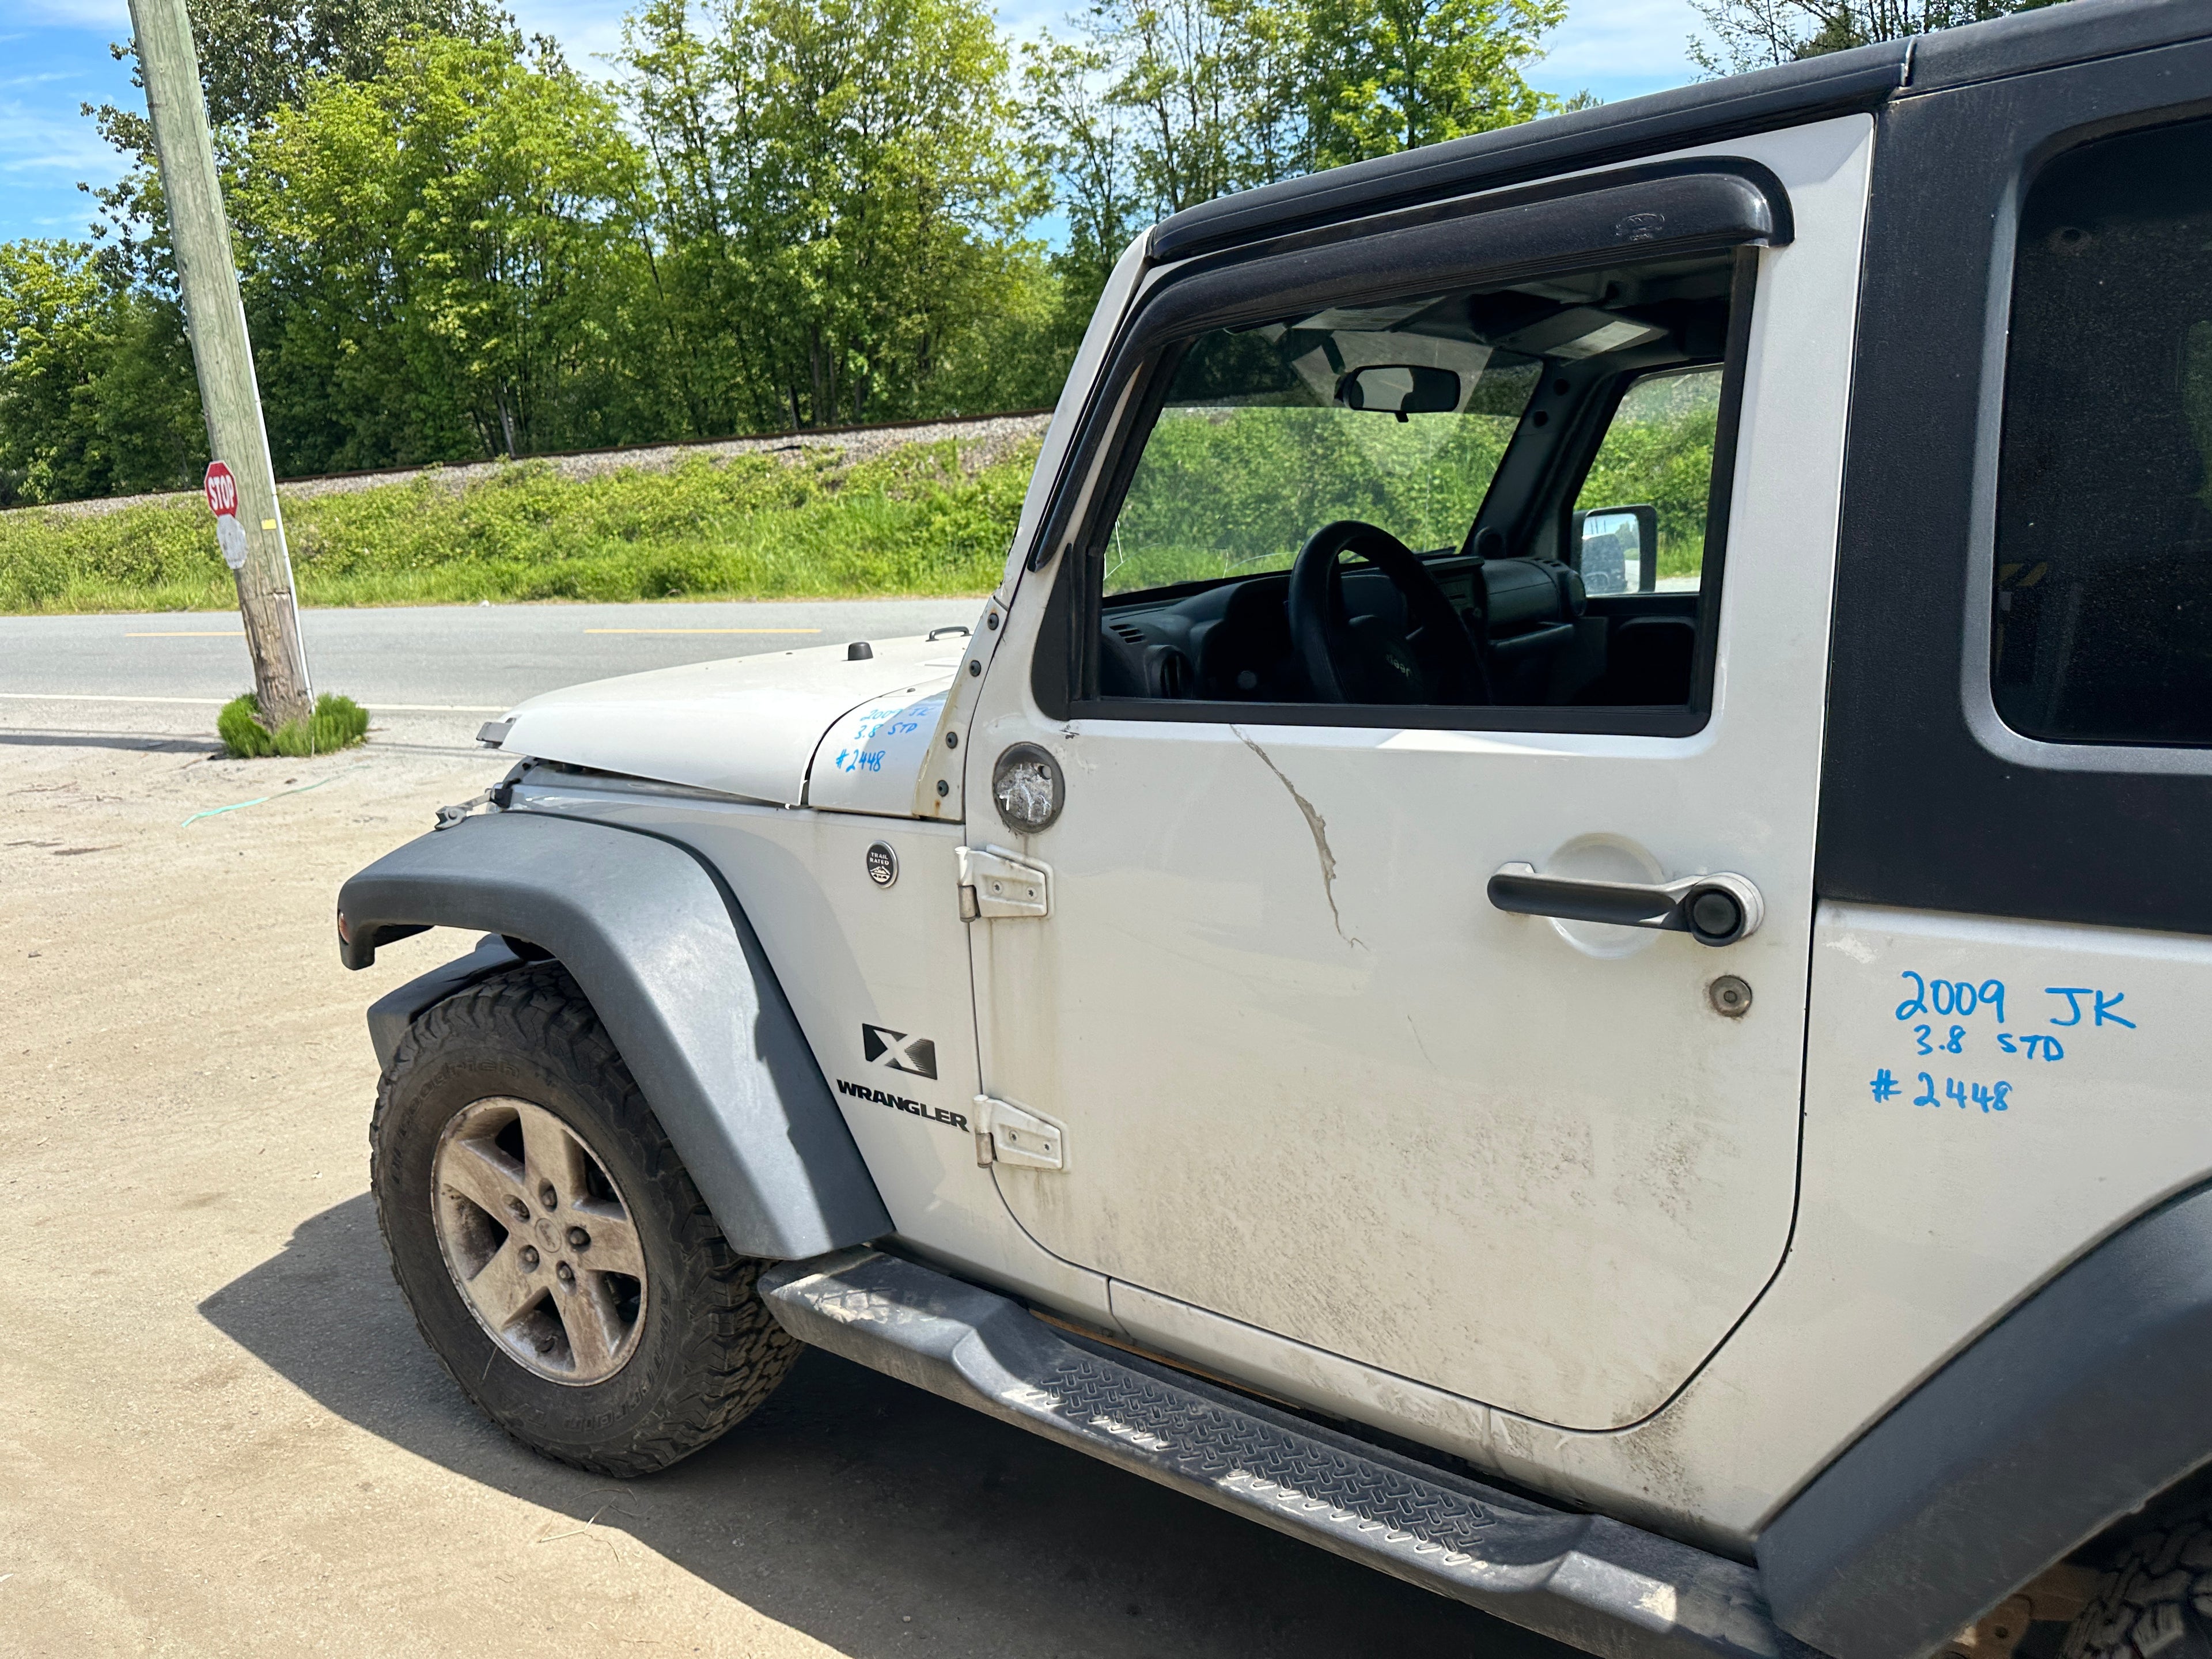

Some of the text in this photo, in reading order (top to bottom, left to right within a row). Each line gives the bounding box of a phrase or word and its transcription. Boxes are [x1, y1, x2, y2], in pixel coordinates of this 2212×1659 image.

[207, 475, 234, 510] STOP
[854, 722, 918, 740] 3.8 STD
[835, 748, 886, 772] #2448
[869, 857, 889, 866] RATED
[870, 852, 888, 860] TRAIL
[1895, 971, 2137, 1029] 2009 JK
[1914, 1024, 2065, 1061] 3.8 STD
[836, 1079, 970, 1133] WRANGLER
